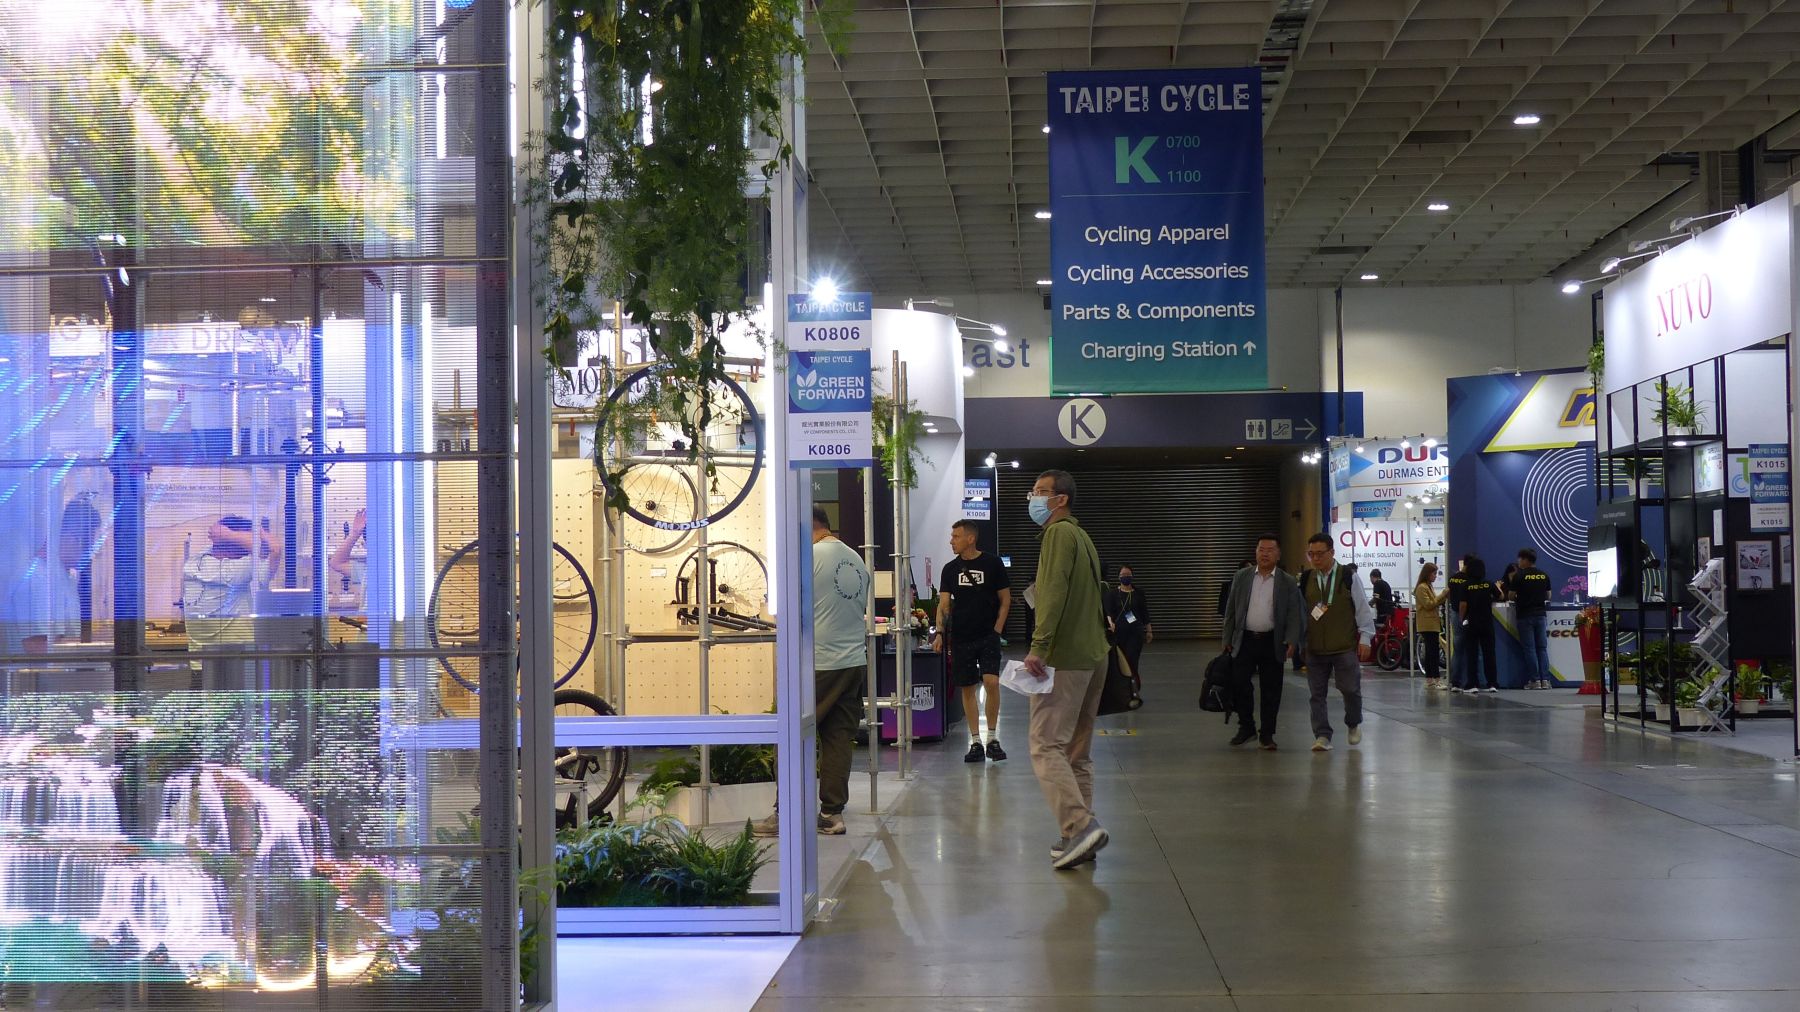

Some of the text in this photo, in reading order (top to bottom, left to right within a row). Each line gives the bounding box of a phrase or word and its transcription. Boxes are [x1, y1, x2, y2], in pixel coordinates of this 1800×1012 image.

[1059, 84, 1249, 114] TAIPEI CYCLE
[1166, 135, 1201, 149] 0700
[1115, 136, 1160, 184] K
[1167, 170, 1201, 183] 1100
[1085, 224, 1229, 245] Cycling Apparel
[1067, 263, 1249, 284] Cycling Accessories
[832, 301, 865, 313] CYCLE
[1063, 302, 1255, 321] Parts & Components
[1657, 273, 1712, 337] NUVO
[805, 326, 860, 342] K0806
[963, 338, 1031, 368] ast
[1081, 341, 1237, 361] Charging Station
[832, 355, 853, 363] CYCLE
[818, 376, 865, 388] GREEN
[798, 388, 866, 400] FORWARD
[1070, 404, 1096, 438] K
[808, 444, 851, 456] K0806
[1756, 460, 1786, 469] K1015
[1378, 468, 1424, 479] DURMAS
[1373, 487, 1402, 498] avnu
[1754, 490, 1789, 498] FORWARD
[654, 517, 710, 531] MODUS
[1340, 529, 1405, 547] avnu
